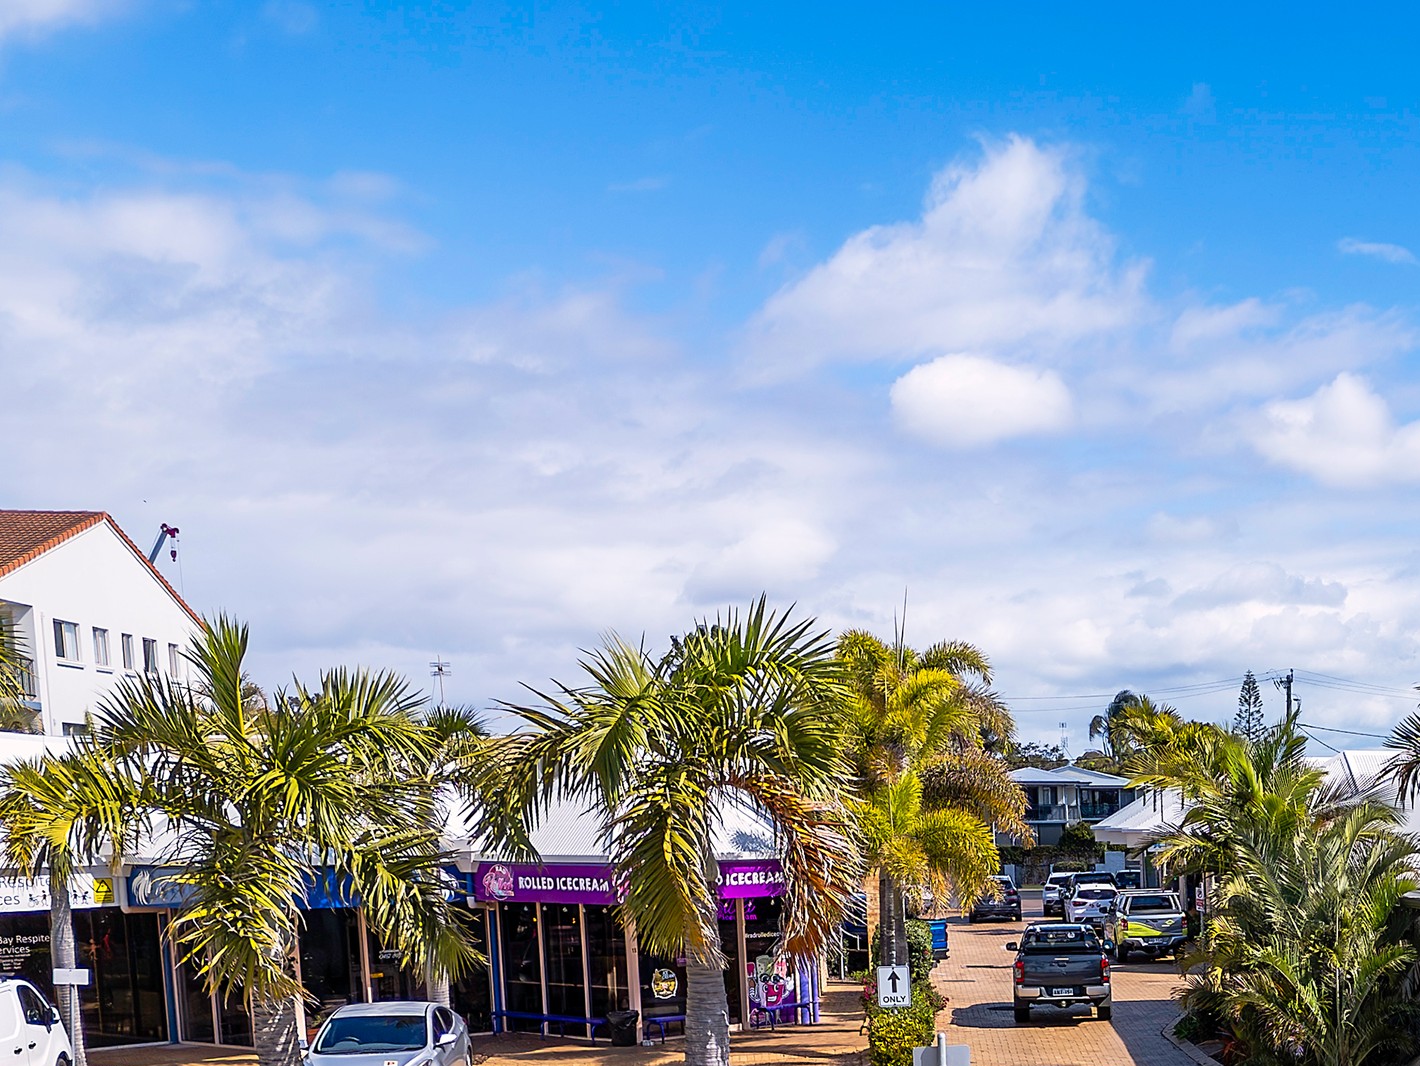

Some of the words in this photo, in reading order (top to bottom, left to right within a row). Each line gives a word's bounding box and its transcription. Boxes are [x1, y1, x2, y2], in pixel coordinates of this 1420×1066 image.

[518, 876, 554, 890] ROLLED
[556, 877, 610, 892] ICECREAM
[16, 934, 50, 943] Respite
[883, 995, 906, 1004] ONLY
